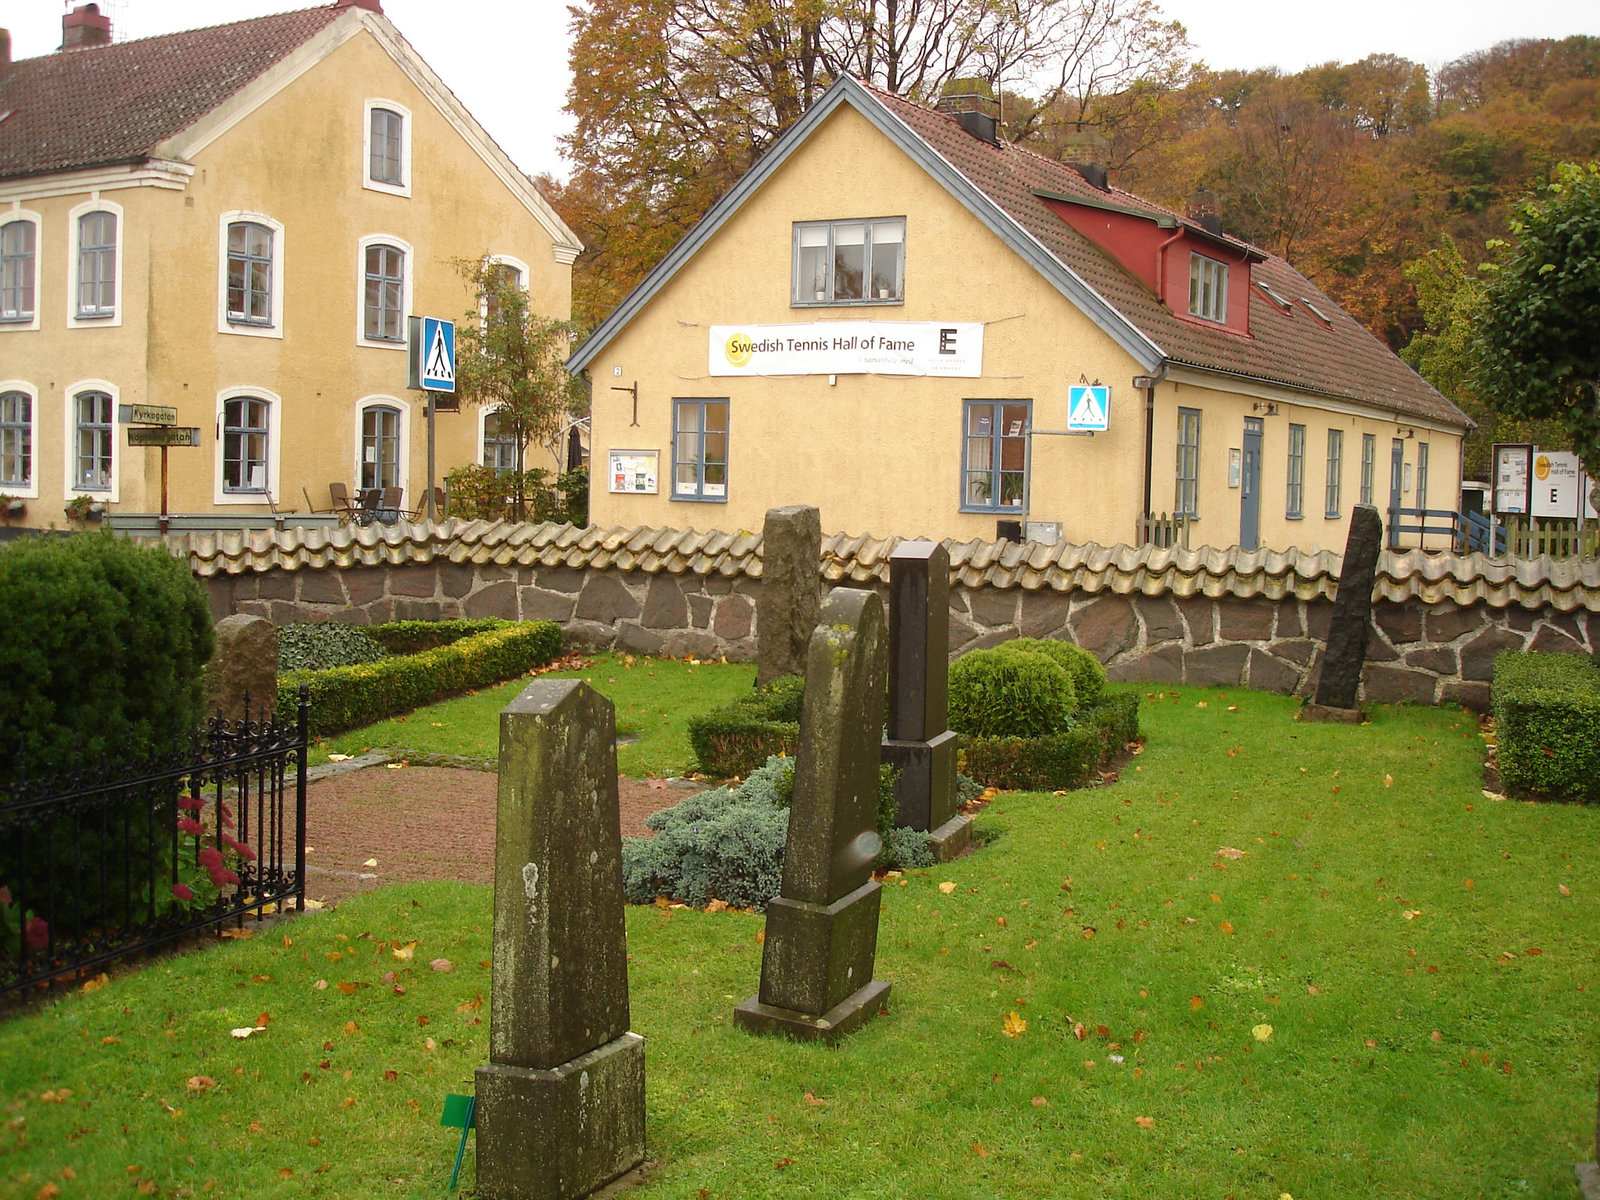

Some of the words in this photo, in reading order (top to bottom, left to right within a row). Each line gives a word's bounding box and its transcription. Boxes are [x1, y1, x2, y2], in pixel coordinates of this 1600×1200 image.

[731, 339, 784, 354] Swedish
[787, 338, 829, 352] Tennis
[833, 336, 858, 351] Hall
[860, 336, 877, 350] of
[879, 336, 915, 352] Fame
[939, 328, 958, 354] E
[134, 409, 176, 421] Kyrkogatan
[131, 432, 190, 443] Köpgatan
[1550, 489, 1557, 502] E
